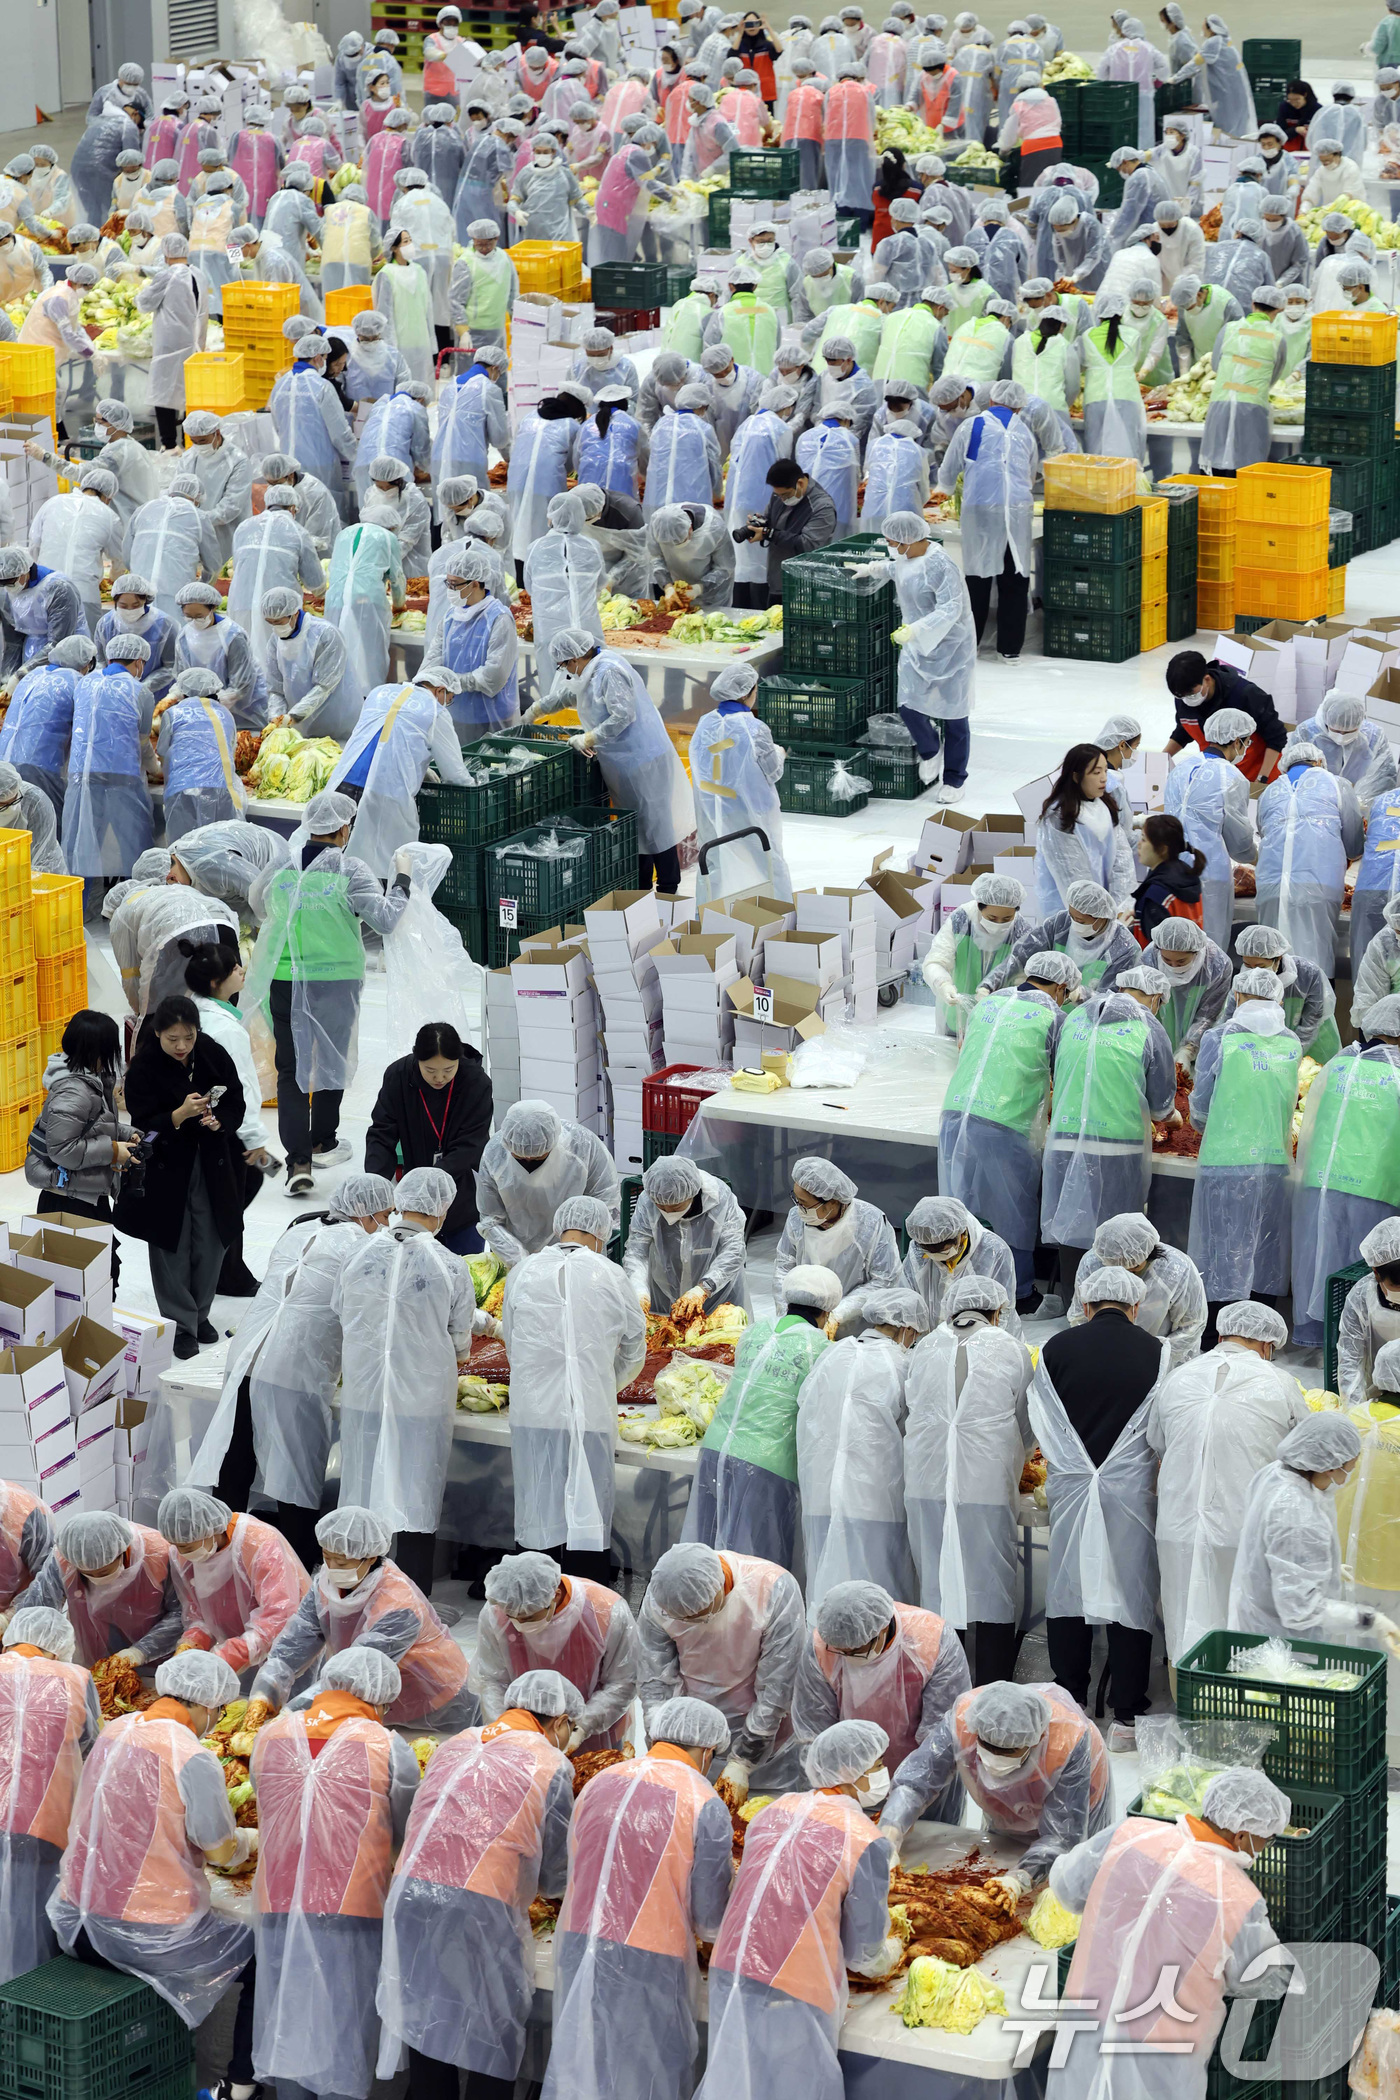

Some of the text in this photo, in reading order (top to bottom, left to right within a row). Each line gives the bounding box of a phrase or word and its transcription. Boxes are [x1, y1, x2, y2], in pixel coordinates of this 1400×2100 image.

[229, 249, 241, 258] 28
[502, 908, 514, 921] 15
[755, 996, 769, 1012] 10
[306, 1718, 320, 1727] SK
[483, 1726, 498, 1736] SK
